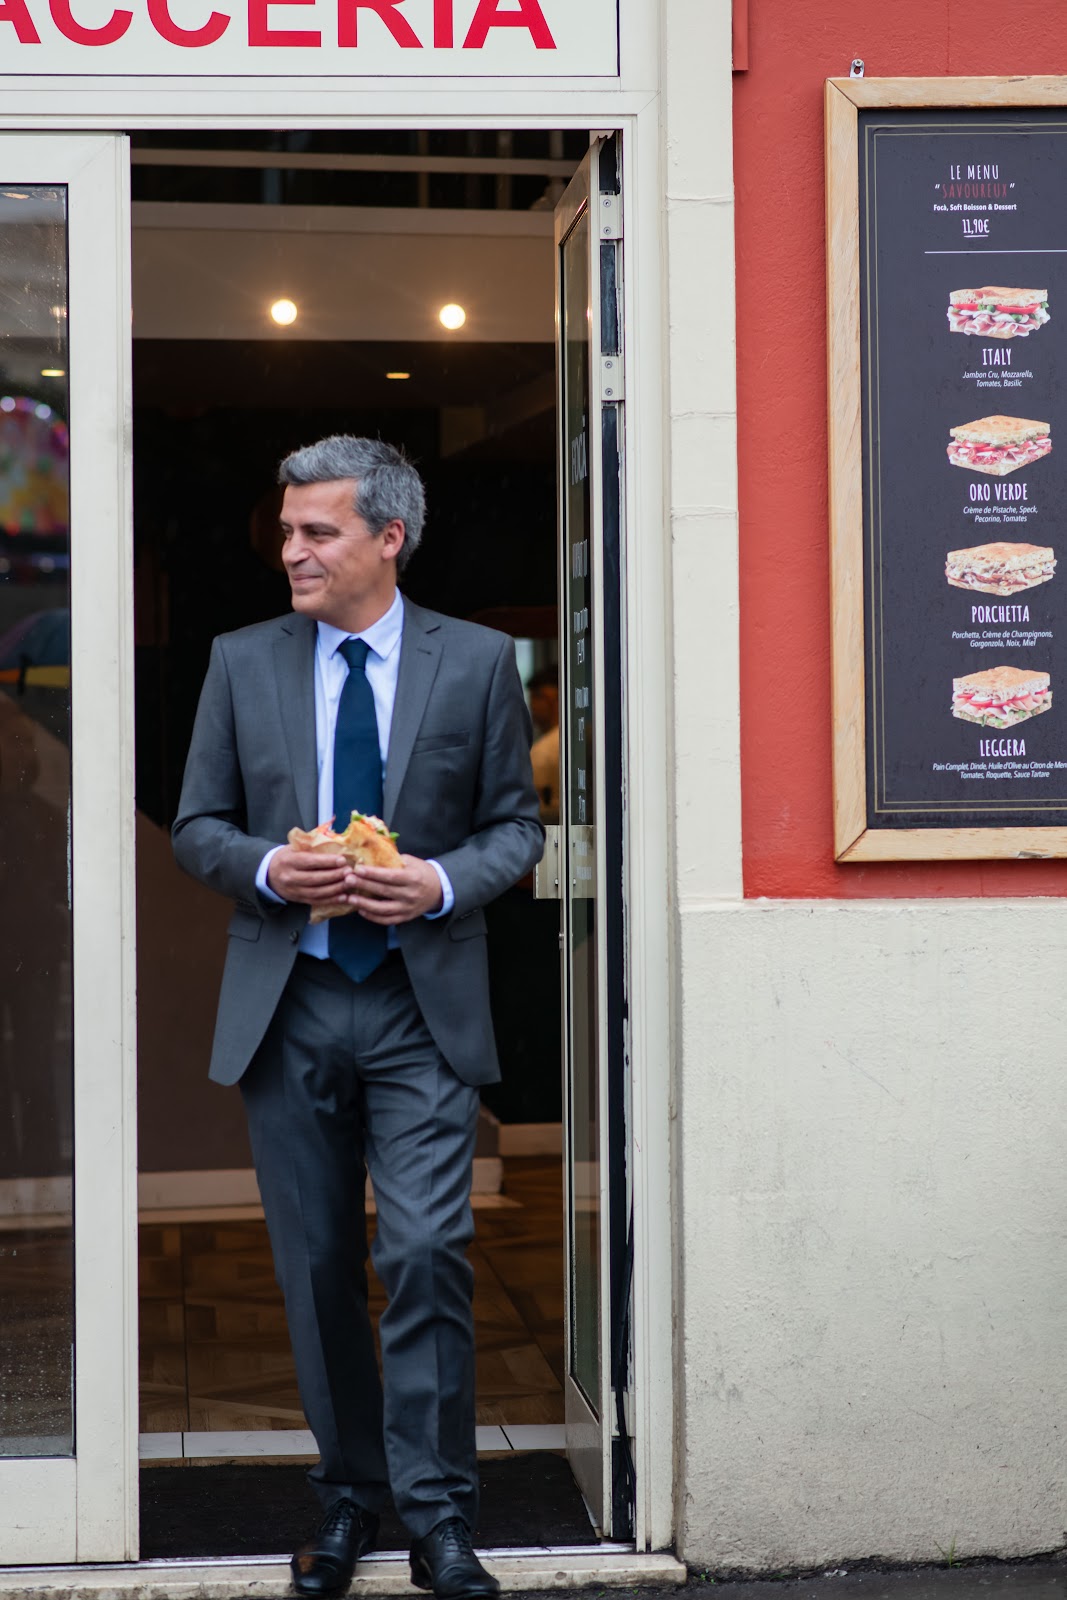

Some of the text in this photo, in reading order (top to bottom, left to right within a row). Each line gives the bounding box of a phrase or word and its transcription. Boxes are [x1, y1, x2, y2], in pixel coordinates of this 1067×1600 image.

[0, 0, 557, 49] CCERIA
[950, 165, 999, 180] LE MENU
[962, 218, 990, 234] 11,90€
[982, 348, 1012, 366] ITALY
[988, 370, 1000, 379] Cru,
[1001, 370, 1034, 378] Mozzarella,
[970, 483, 1028, 501] ORO VERDE
[992, 506, 1018, 514] Pistache,
[1019, 506, 1038, 514] Speck,
[972, 606, 1030, 623] PORCHETTA
[952, 631, 980, 639] Porchetta,
[1011, 630, 1053, 639] Champignons,
[970, 640, 1004, 649] Gorgonzola,
[980, 739, 1026, 756] LEGGERA
[986, 772, 1012, 780] Roquette,
